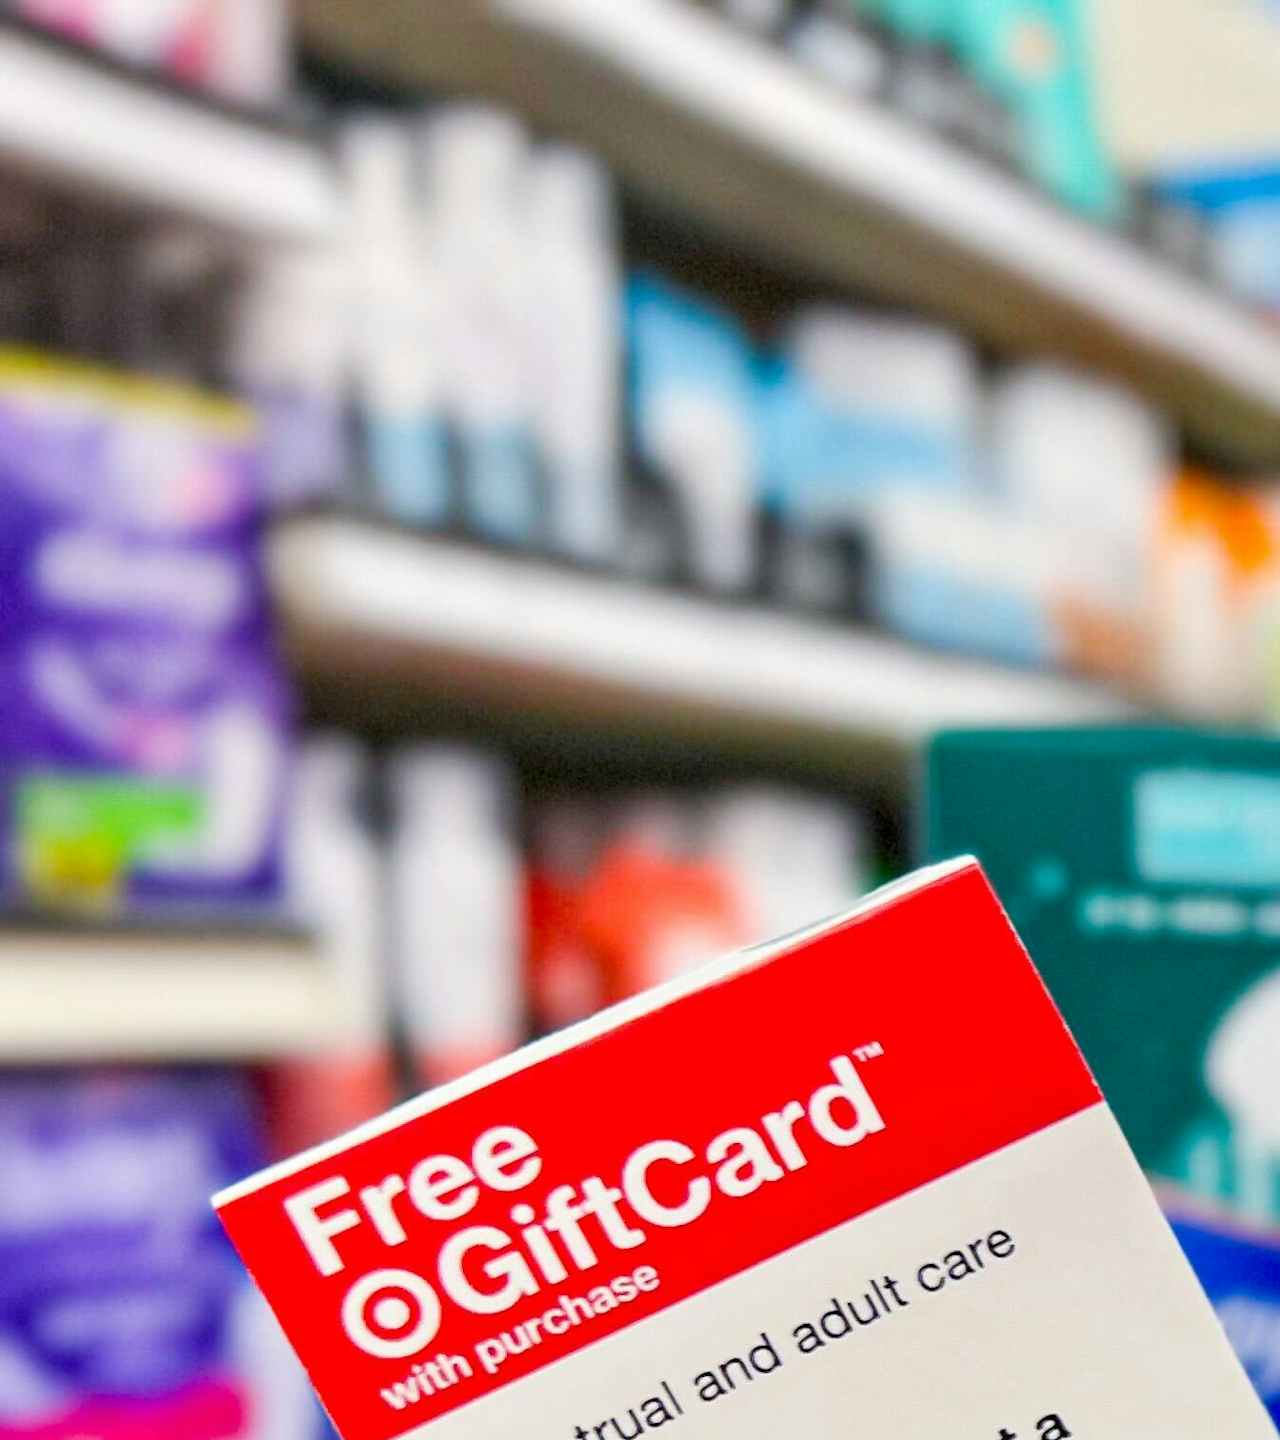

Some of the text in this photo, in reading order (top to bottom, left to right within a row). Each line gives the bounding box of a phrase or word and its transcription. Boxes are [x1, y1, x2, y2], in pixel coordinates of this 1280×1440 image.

[282, 1124, 545, 1278] Free
[378, 1262, 662, 1411] with purchase
[692, 1330, 784, 1404] and
[790, 1273, 911, 1356] adult
[915, 1228, 1017, 1294] care
